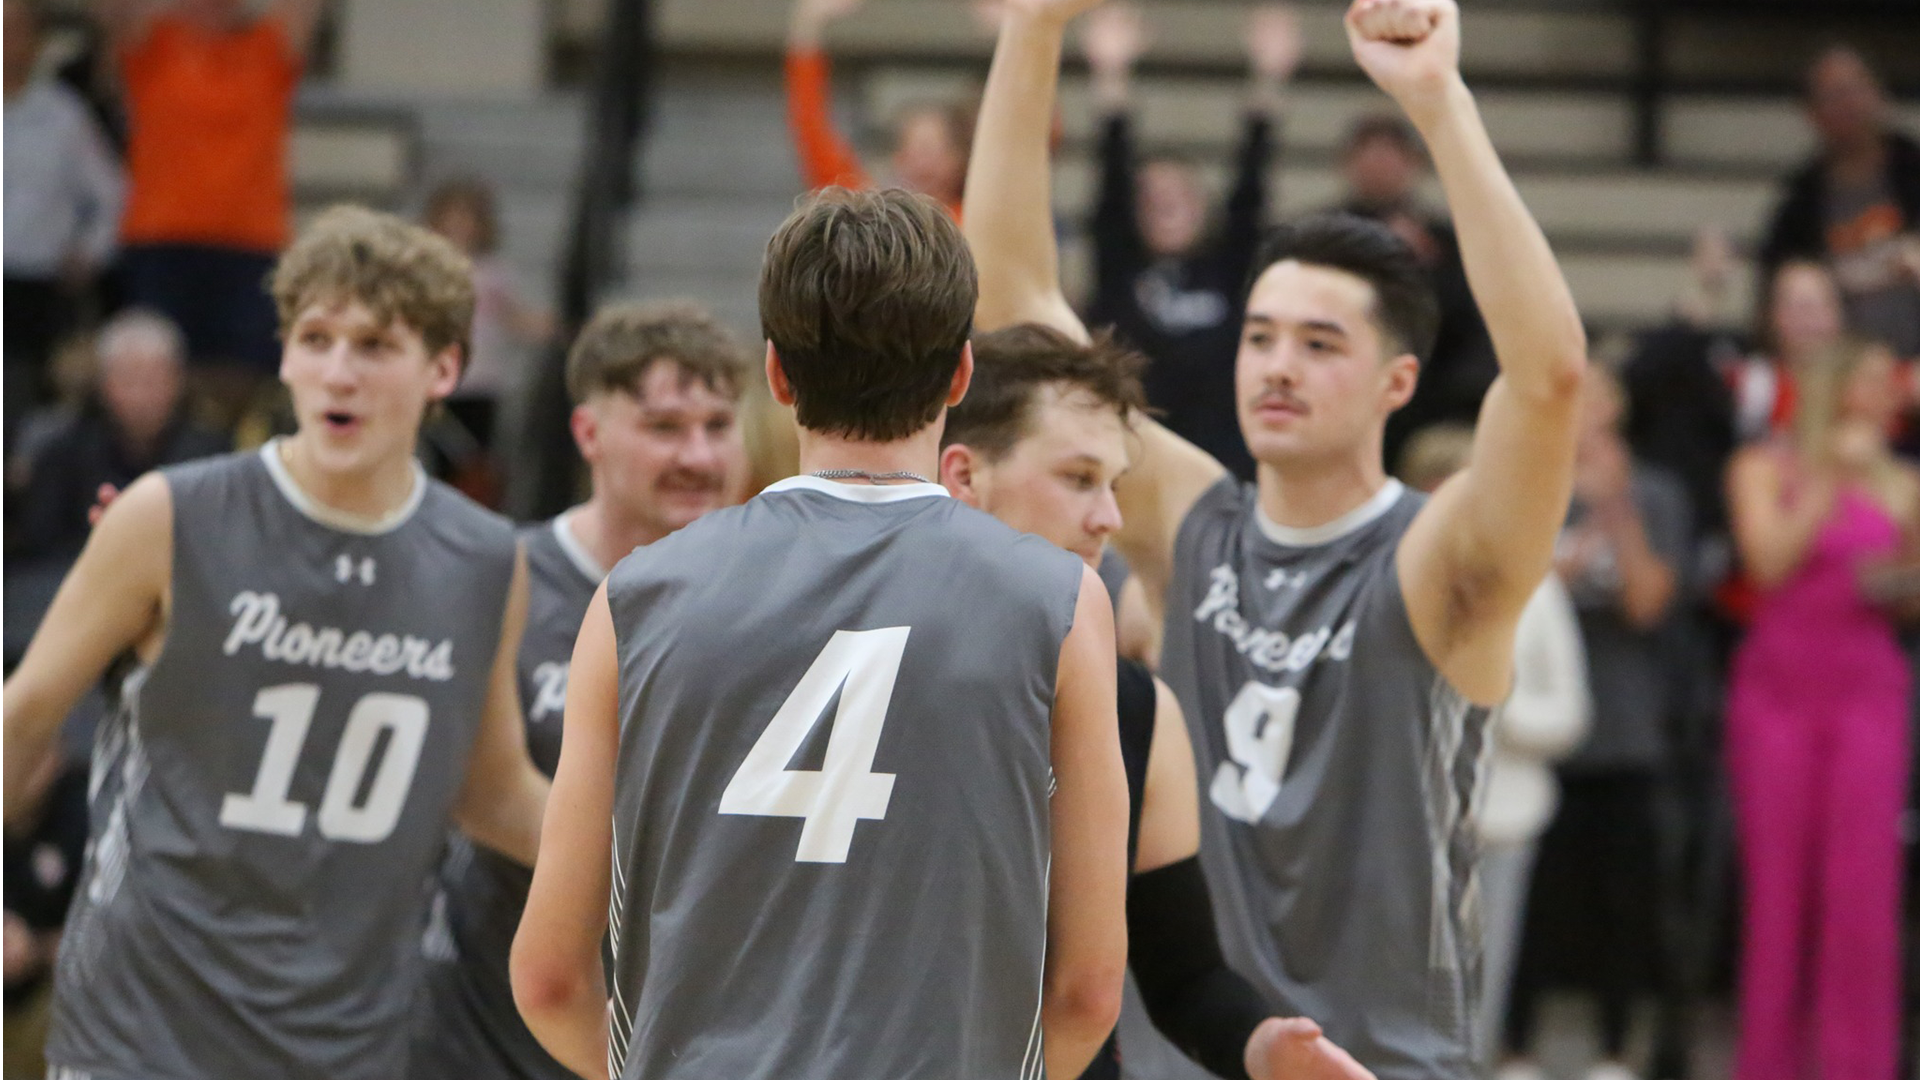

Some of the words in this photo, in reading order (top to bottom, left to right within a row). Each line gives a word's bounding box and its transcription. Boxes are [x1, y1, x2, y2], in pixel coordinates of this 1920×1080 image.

[223, 590, 455, 681] Pioneers
[219, 682, 430, 843] 10
[718, 626, 911, 863] 4
[1210, 680, 1300, 825] 9
